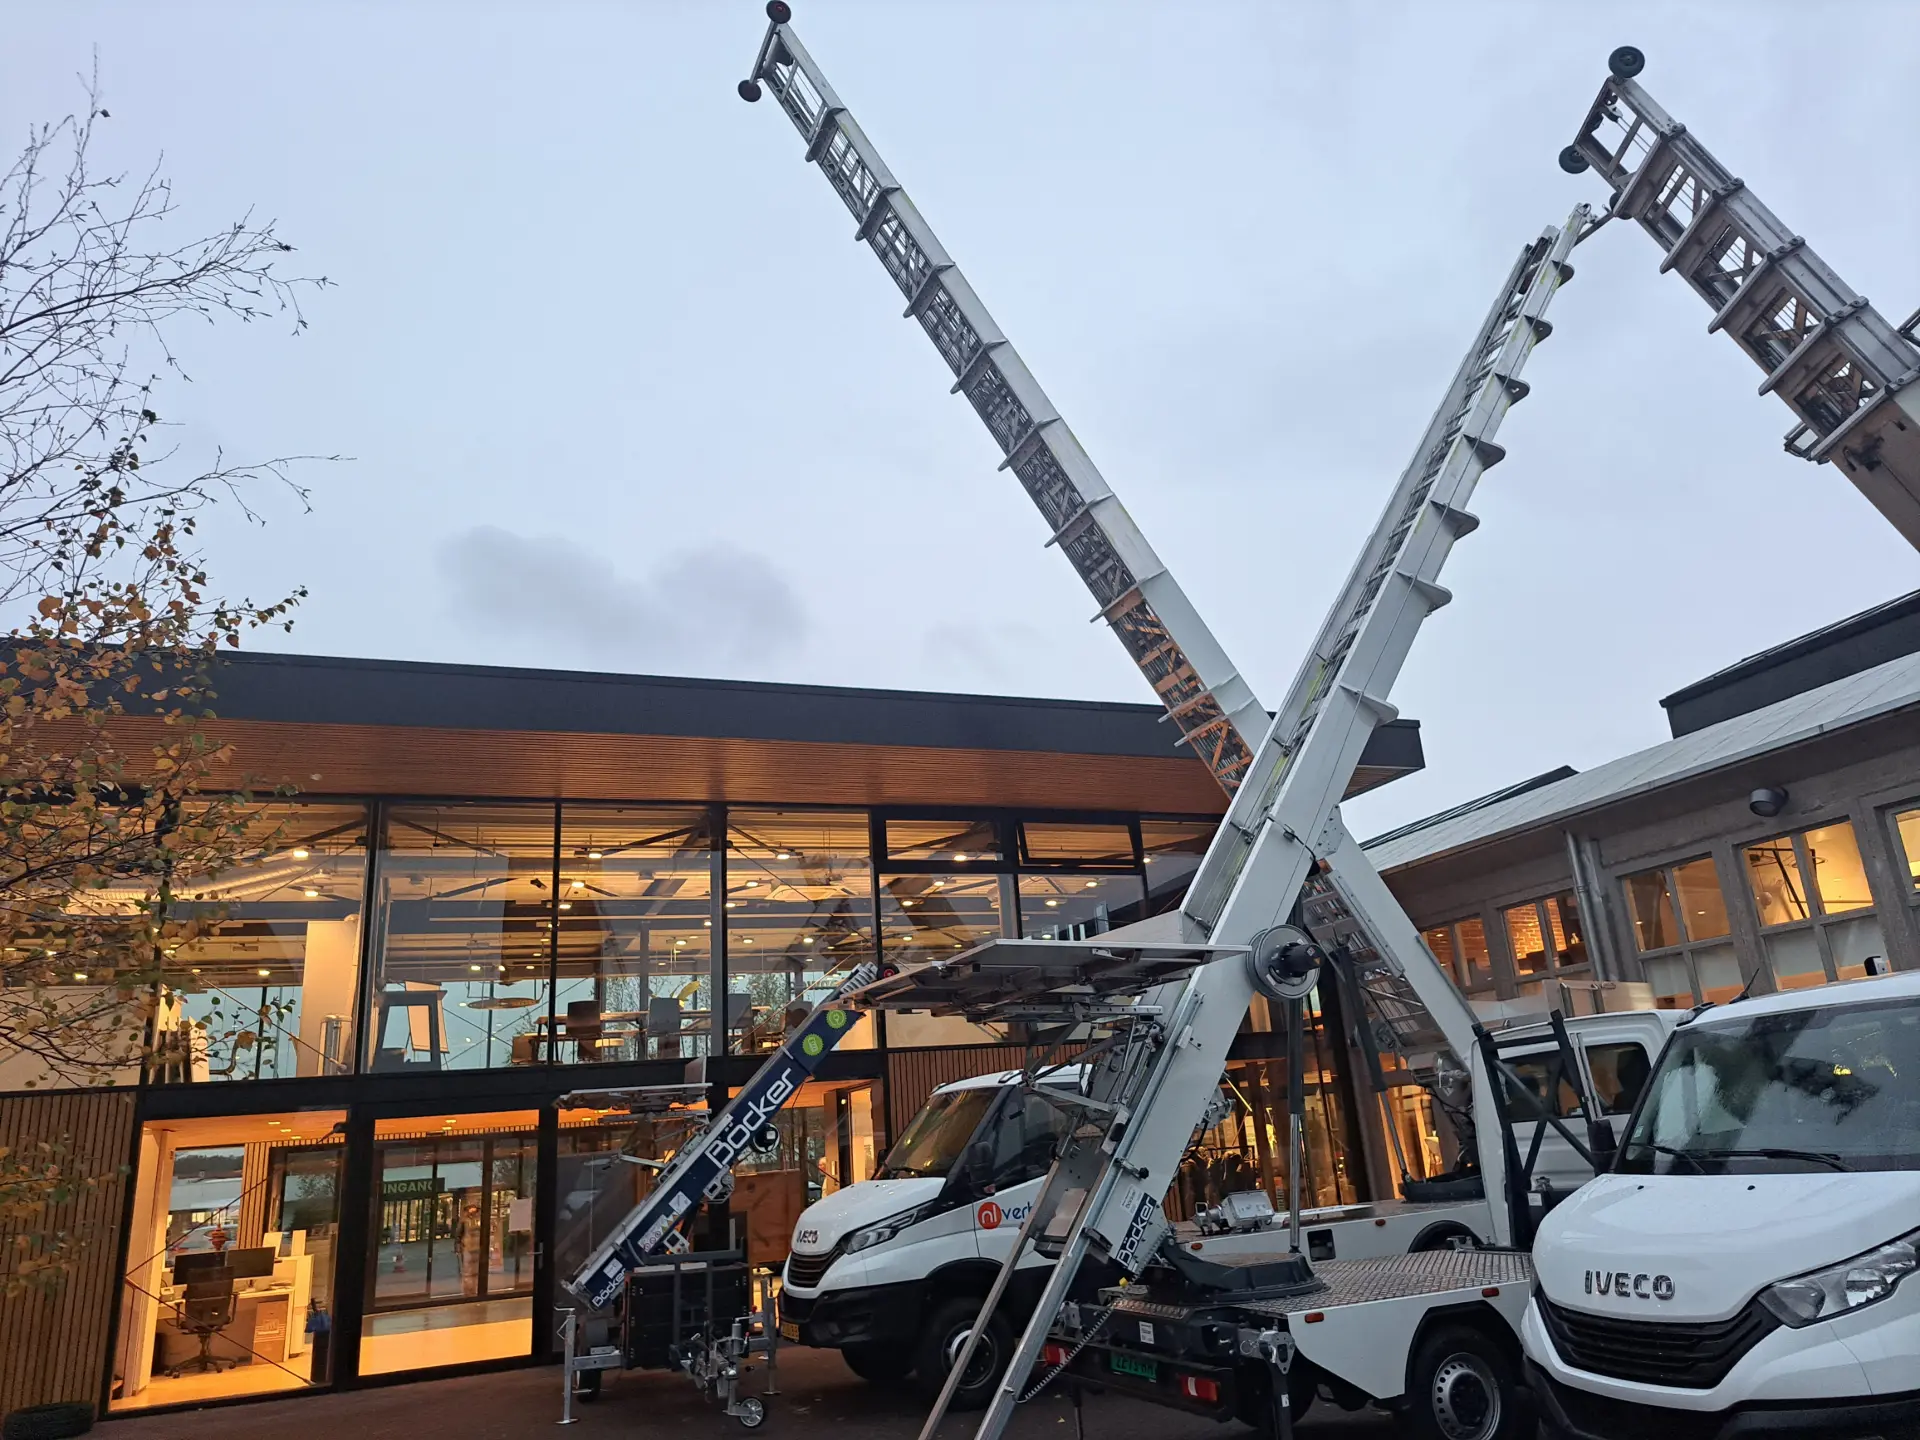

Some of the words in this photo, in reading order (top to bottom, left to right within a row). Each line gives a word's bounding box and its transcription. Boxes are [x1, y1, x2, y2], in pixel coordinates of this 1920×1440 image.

[705, 1067, 794, 1169] Böcker
[1116, 1196, 1154, 1267] Böcker
[592, 1267, 626, 1307] Böcker
[1584, 1269, 1676, 1301] IVECO
